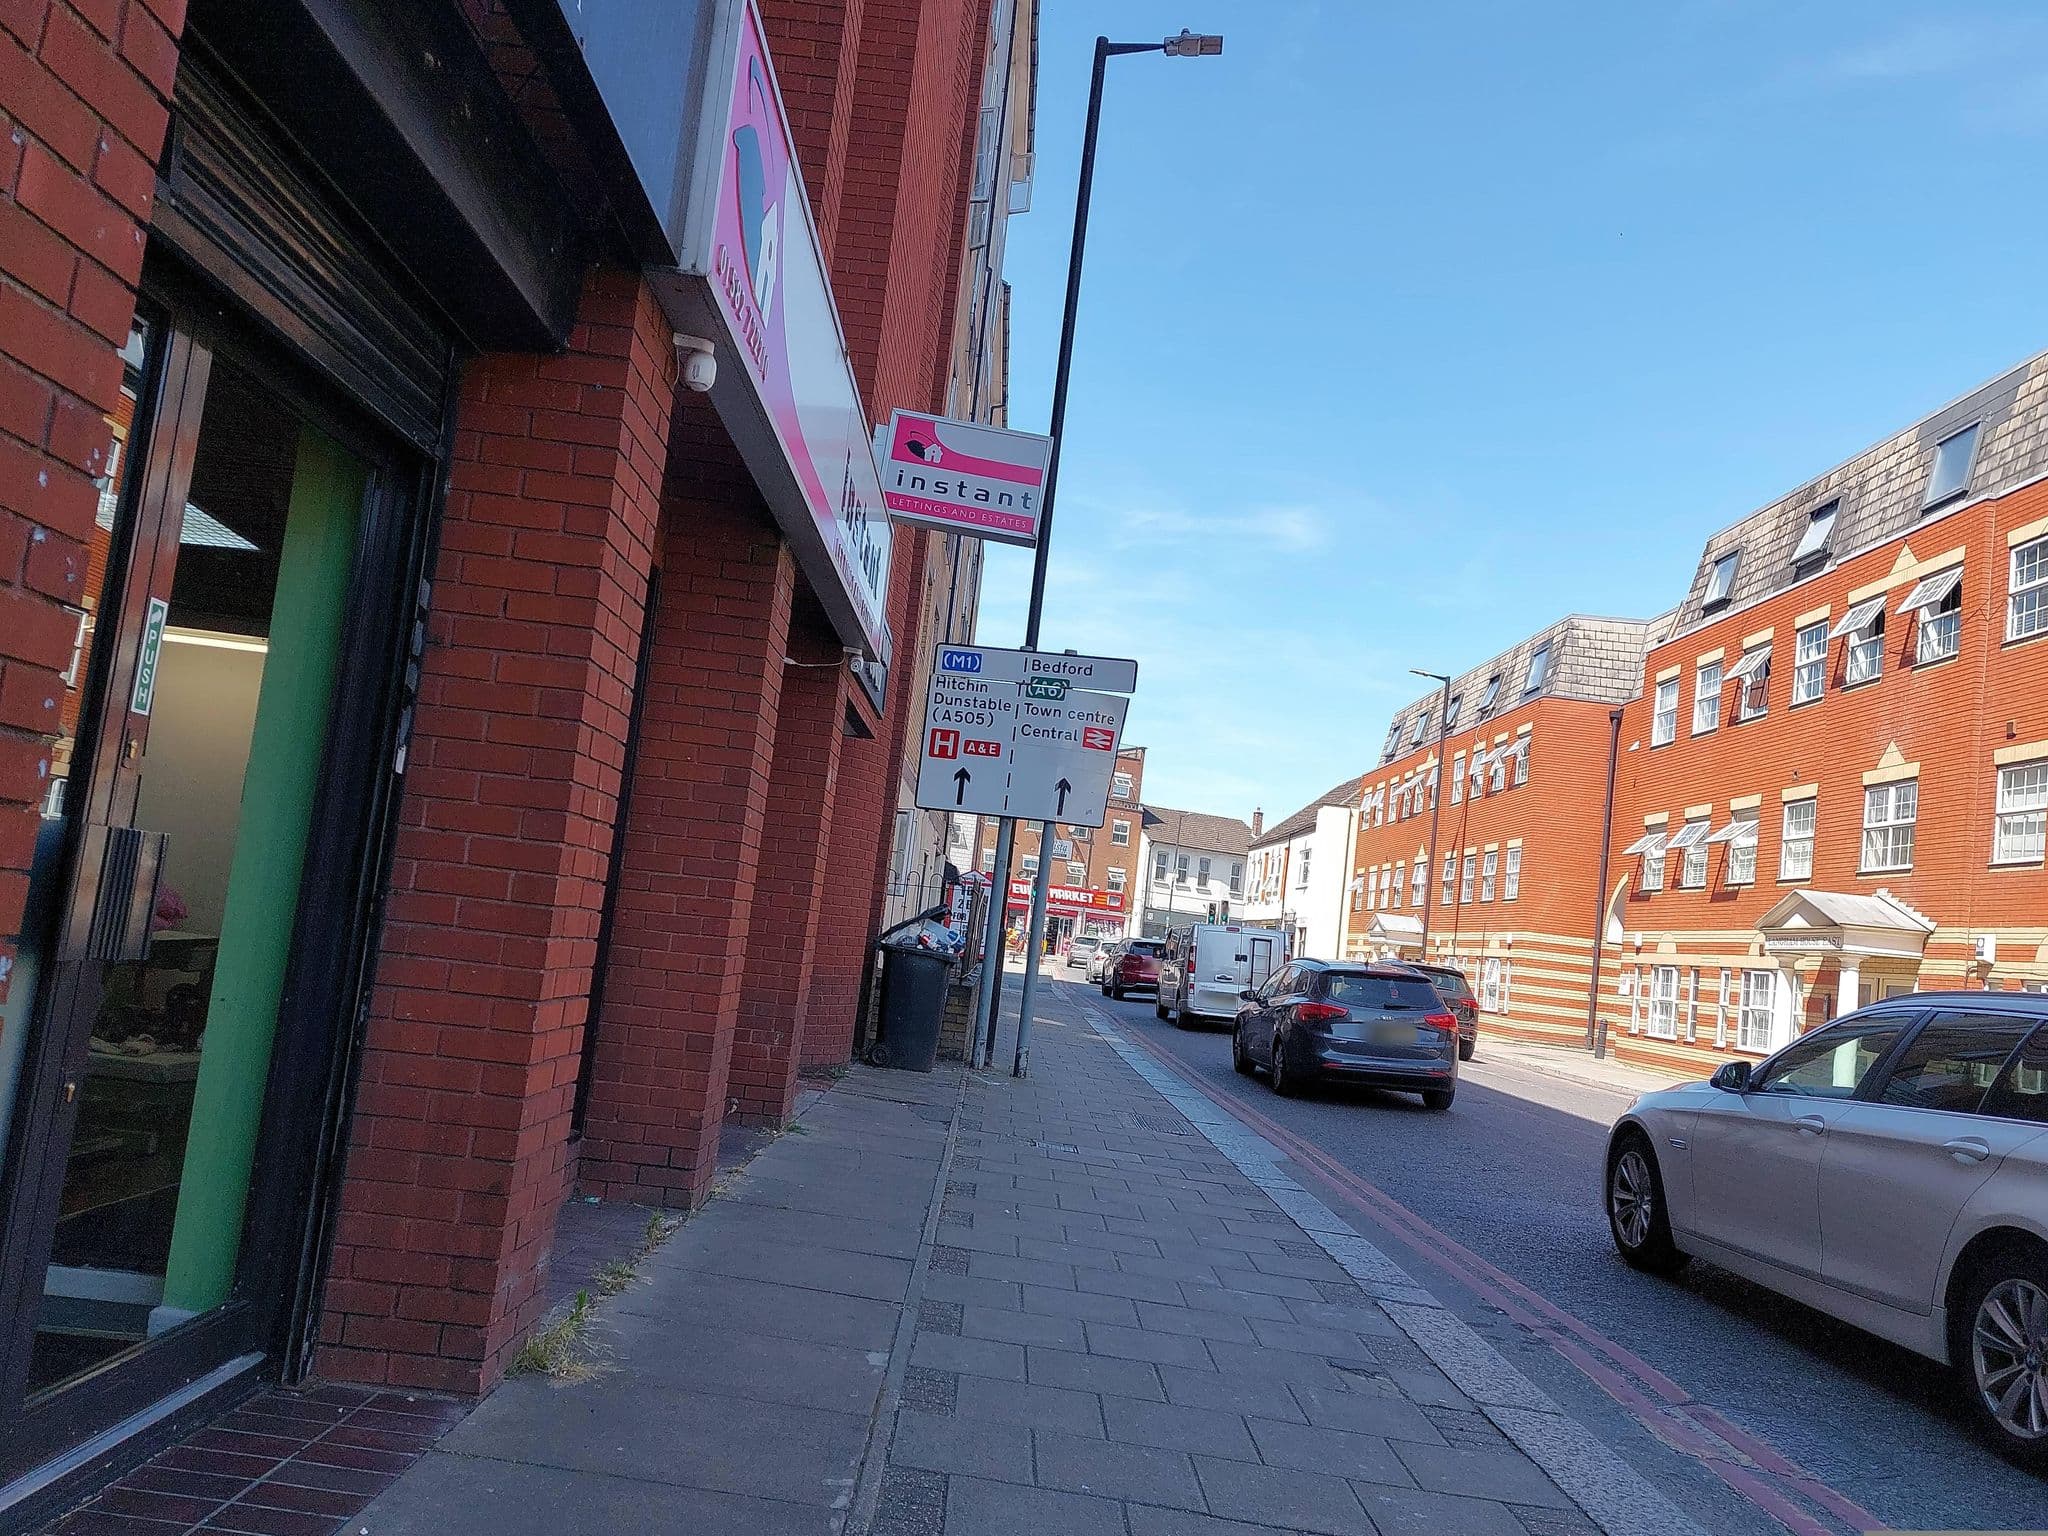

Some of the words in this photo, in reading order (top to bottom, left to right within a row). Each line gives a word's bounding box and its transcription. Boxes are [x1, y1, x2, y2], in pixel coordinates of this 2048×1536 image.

[717, 244, 746, 321] 01582
[896, 469, 1033, 510] instant
[892, 497, 947, 515] LETTINGS
[951, 508, 976, 520] AND
[981, 514, 1027, 529] ESTATES
[137, 629, 157, 704] PUSH
[944, 652, 981, 671] (M1)
[1031, 659, 1093, 676] Bedford
[935, 676, 989, 693] Hitchin
[1027, 679, 1069, 699] (A6)
[934, 692, 1011, 711] Dunstable
[933, 707, 994, 728] (A505)
[1024, 702, 1061, 719] Town
[1067, 710, 1115, 726] centre
[1021, 723, 1079, 742] Central
[934, 732, 955, 756] H
[967, 742, 997, 755] A&E
[1049, 887, 1095, 904] MARKET
[1822, 936, 1841, 947] EAST
